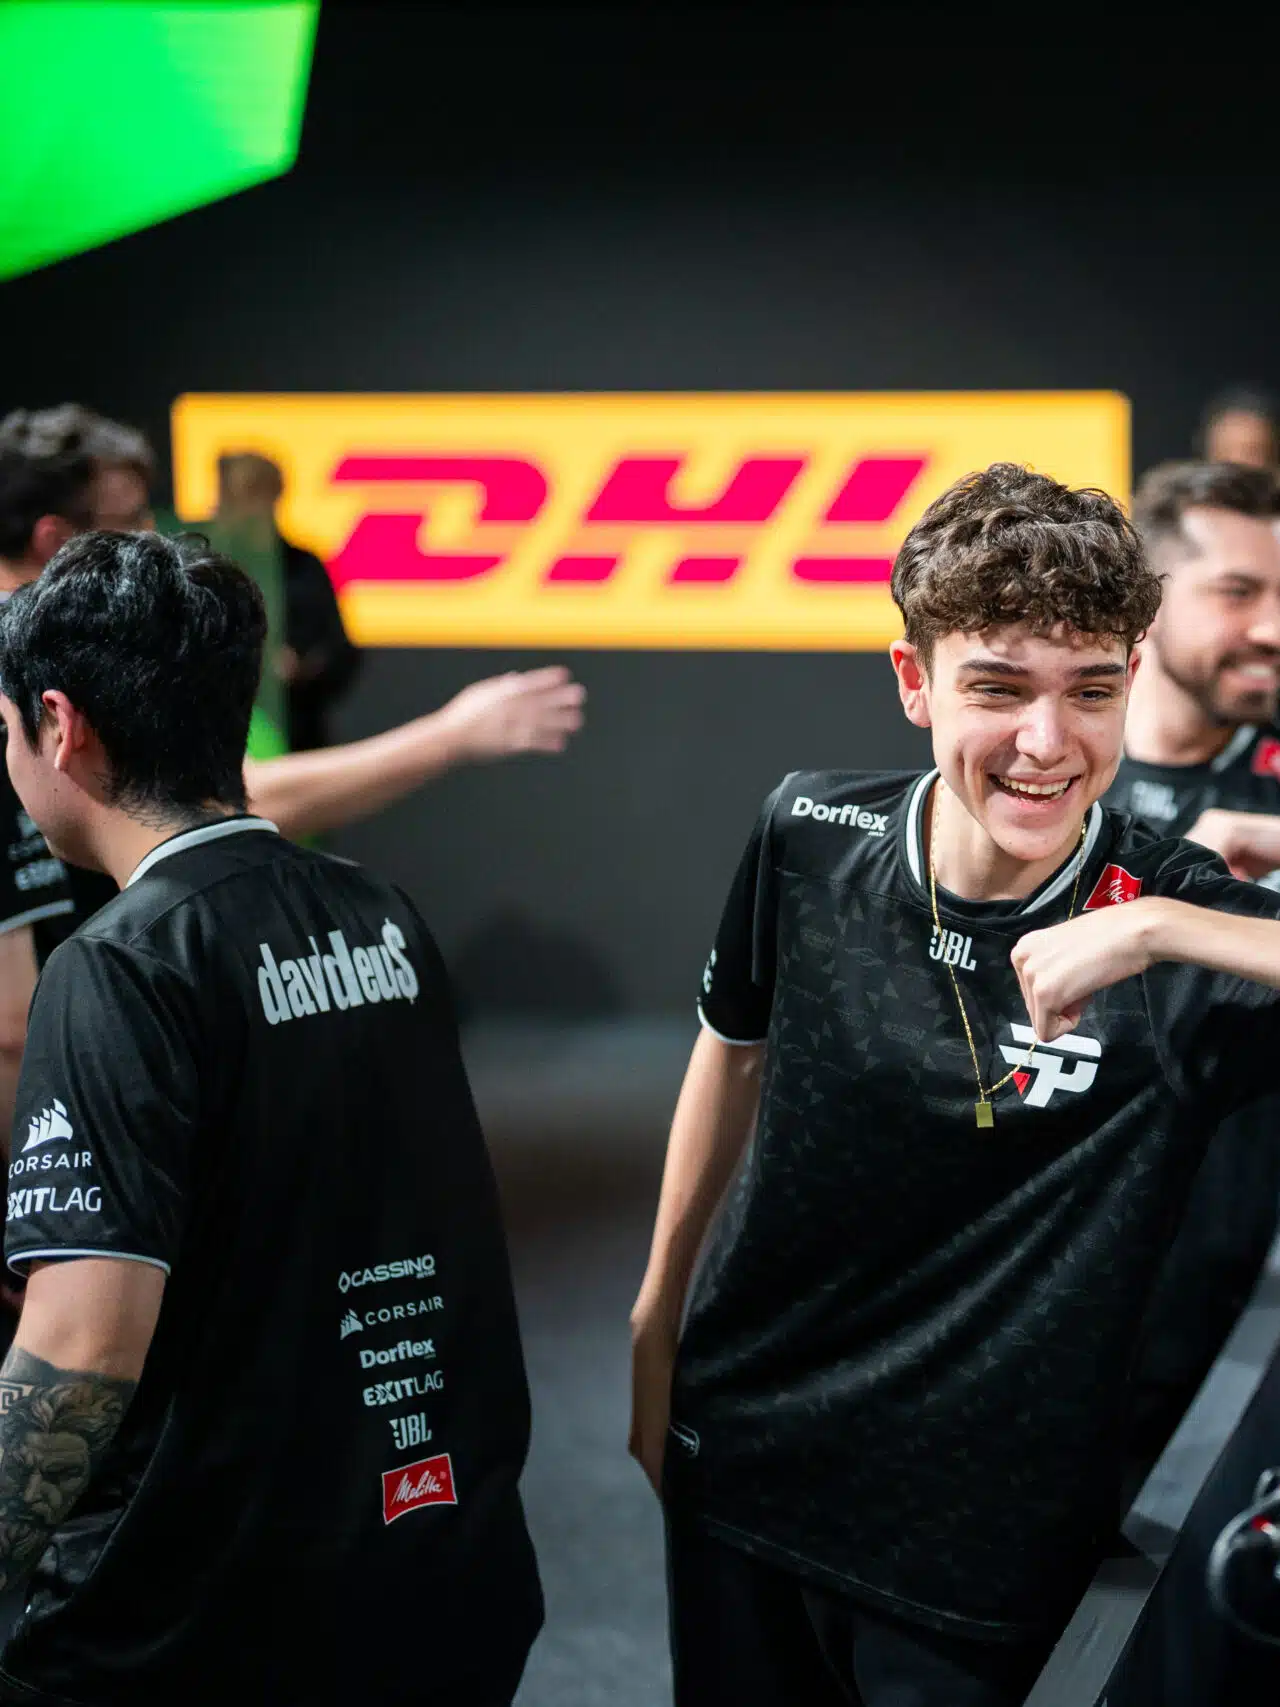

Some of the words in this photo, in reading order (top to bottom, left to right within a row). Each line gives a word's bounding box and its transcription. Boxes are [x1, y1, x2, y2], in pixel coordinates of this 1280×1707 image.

[326, 452, 936, 586] DHL
[791, 796, 889, 832] Dorflex
[929, 925, 977, 972] JBL
[257, 917, 419, 1025] davdeu$
[8, 1151, 92, 1179] CORSAIR
[6, 1187, 102, 1221] XITLAG
[351, 1254, 436, 1288] CASSINO
[365, 1295, 444, 1326] CORSAIR
[360, 1338, 436, 1369] Dorflex
[363, 1370, 444, 1407] EXITLAG
[393, 1412, 433, 1450] JBL
[390, 1470, 443, 1507] Melitta
